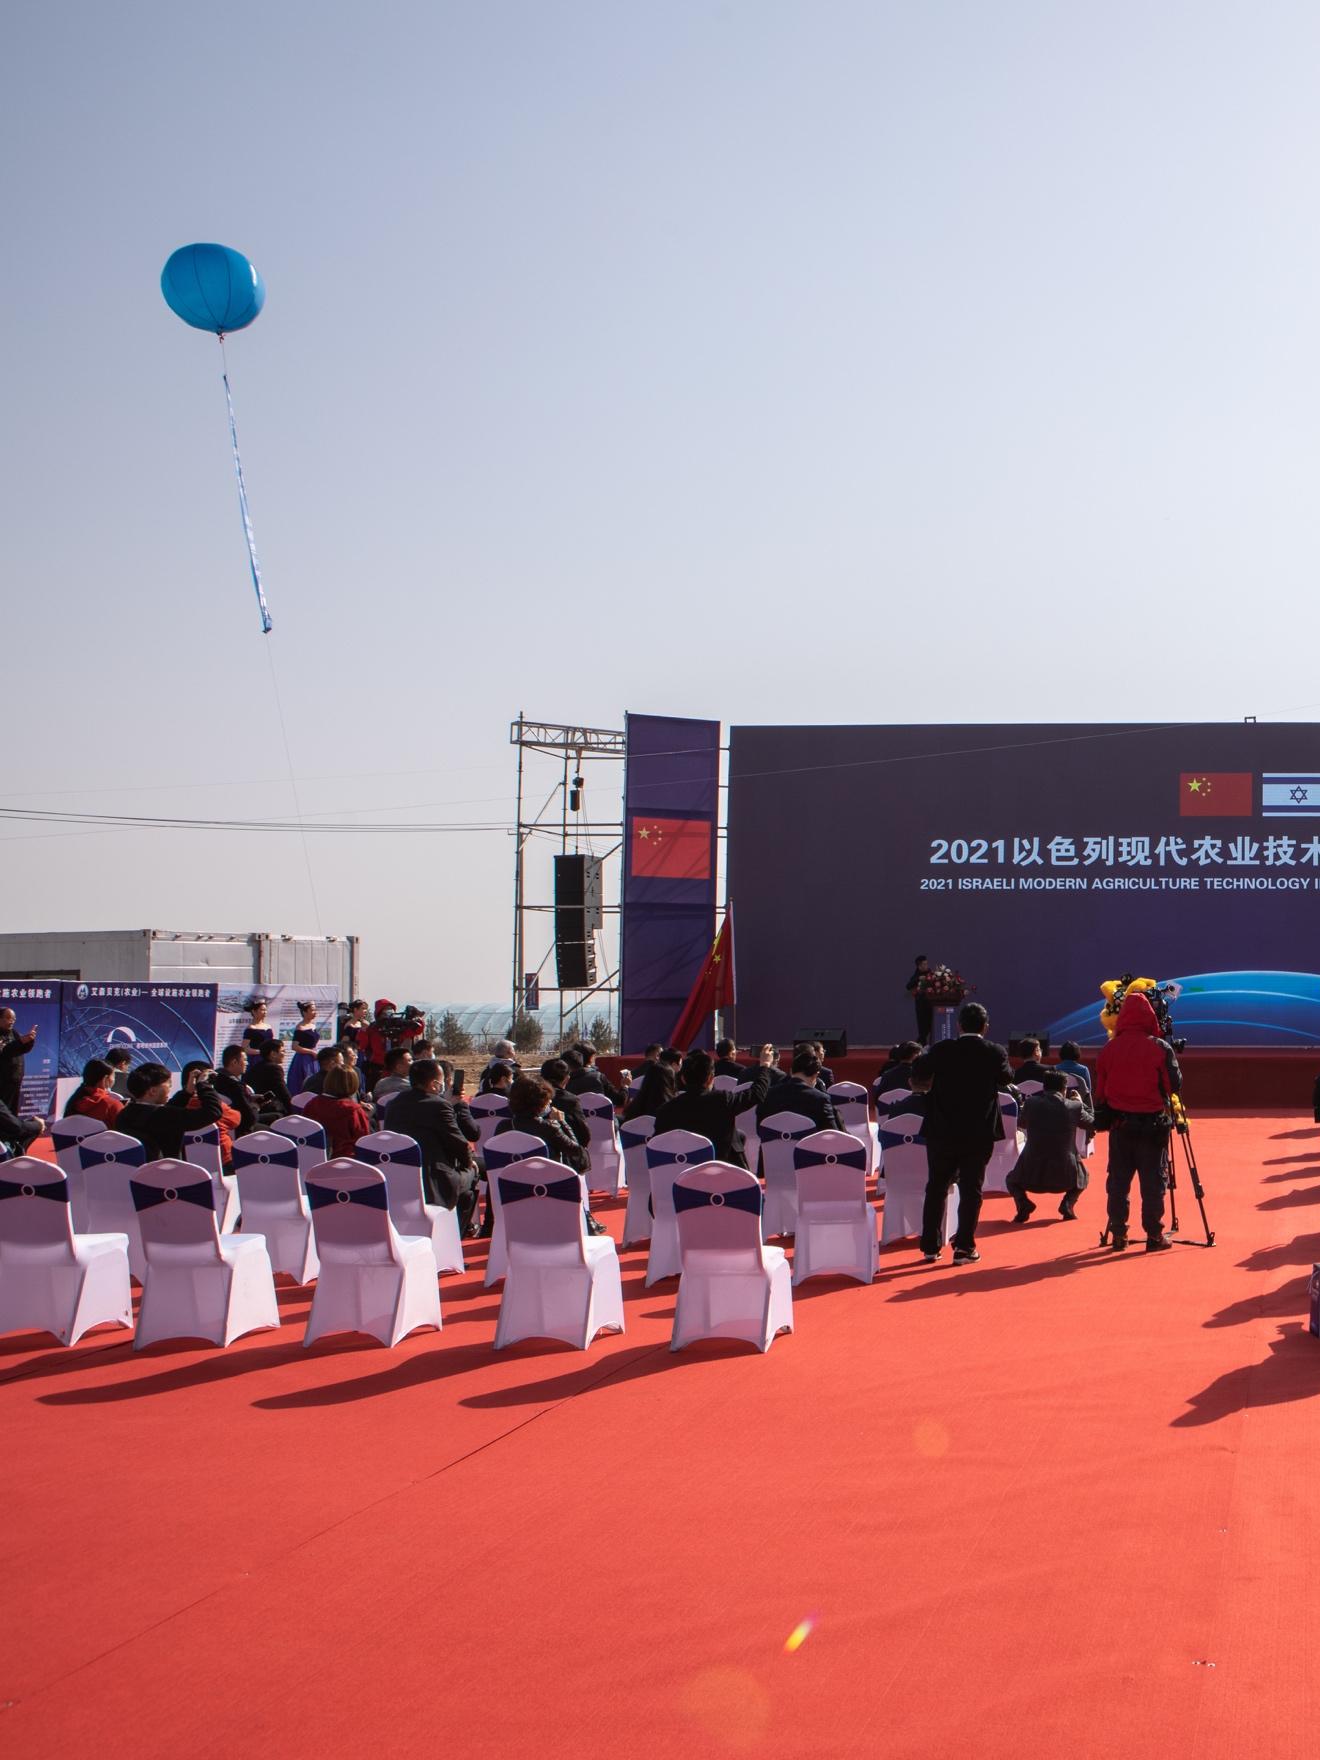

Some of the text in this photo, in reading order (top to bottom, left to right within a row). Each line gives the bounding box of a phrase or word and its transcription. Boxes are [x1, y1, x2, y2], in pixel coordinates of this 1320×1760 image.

[919, 877, 953, 890] 2021
[957, 877, 1015, 890] ISRAELI
[1018, 877, 1088, 890] MODERN
[1091, 877, 1200, 890] AGRICULTURE
[1203, 877, 1311, 891] TECHNOLOGY
[0, 988, 52, 999] 施农业领跑者
